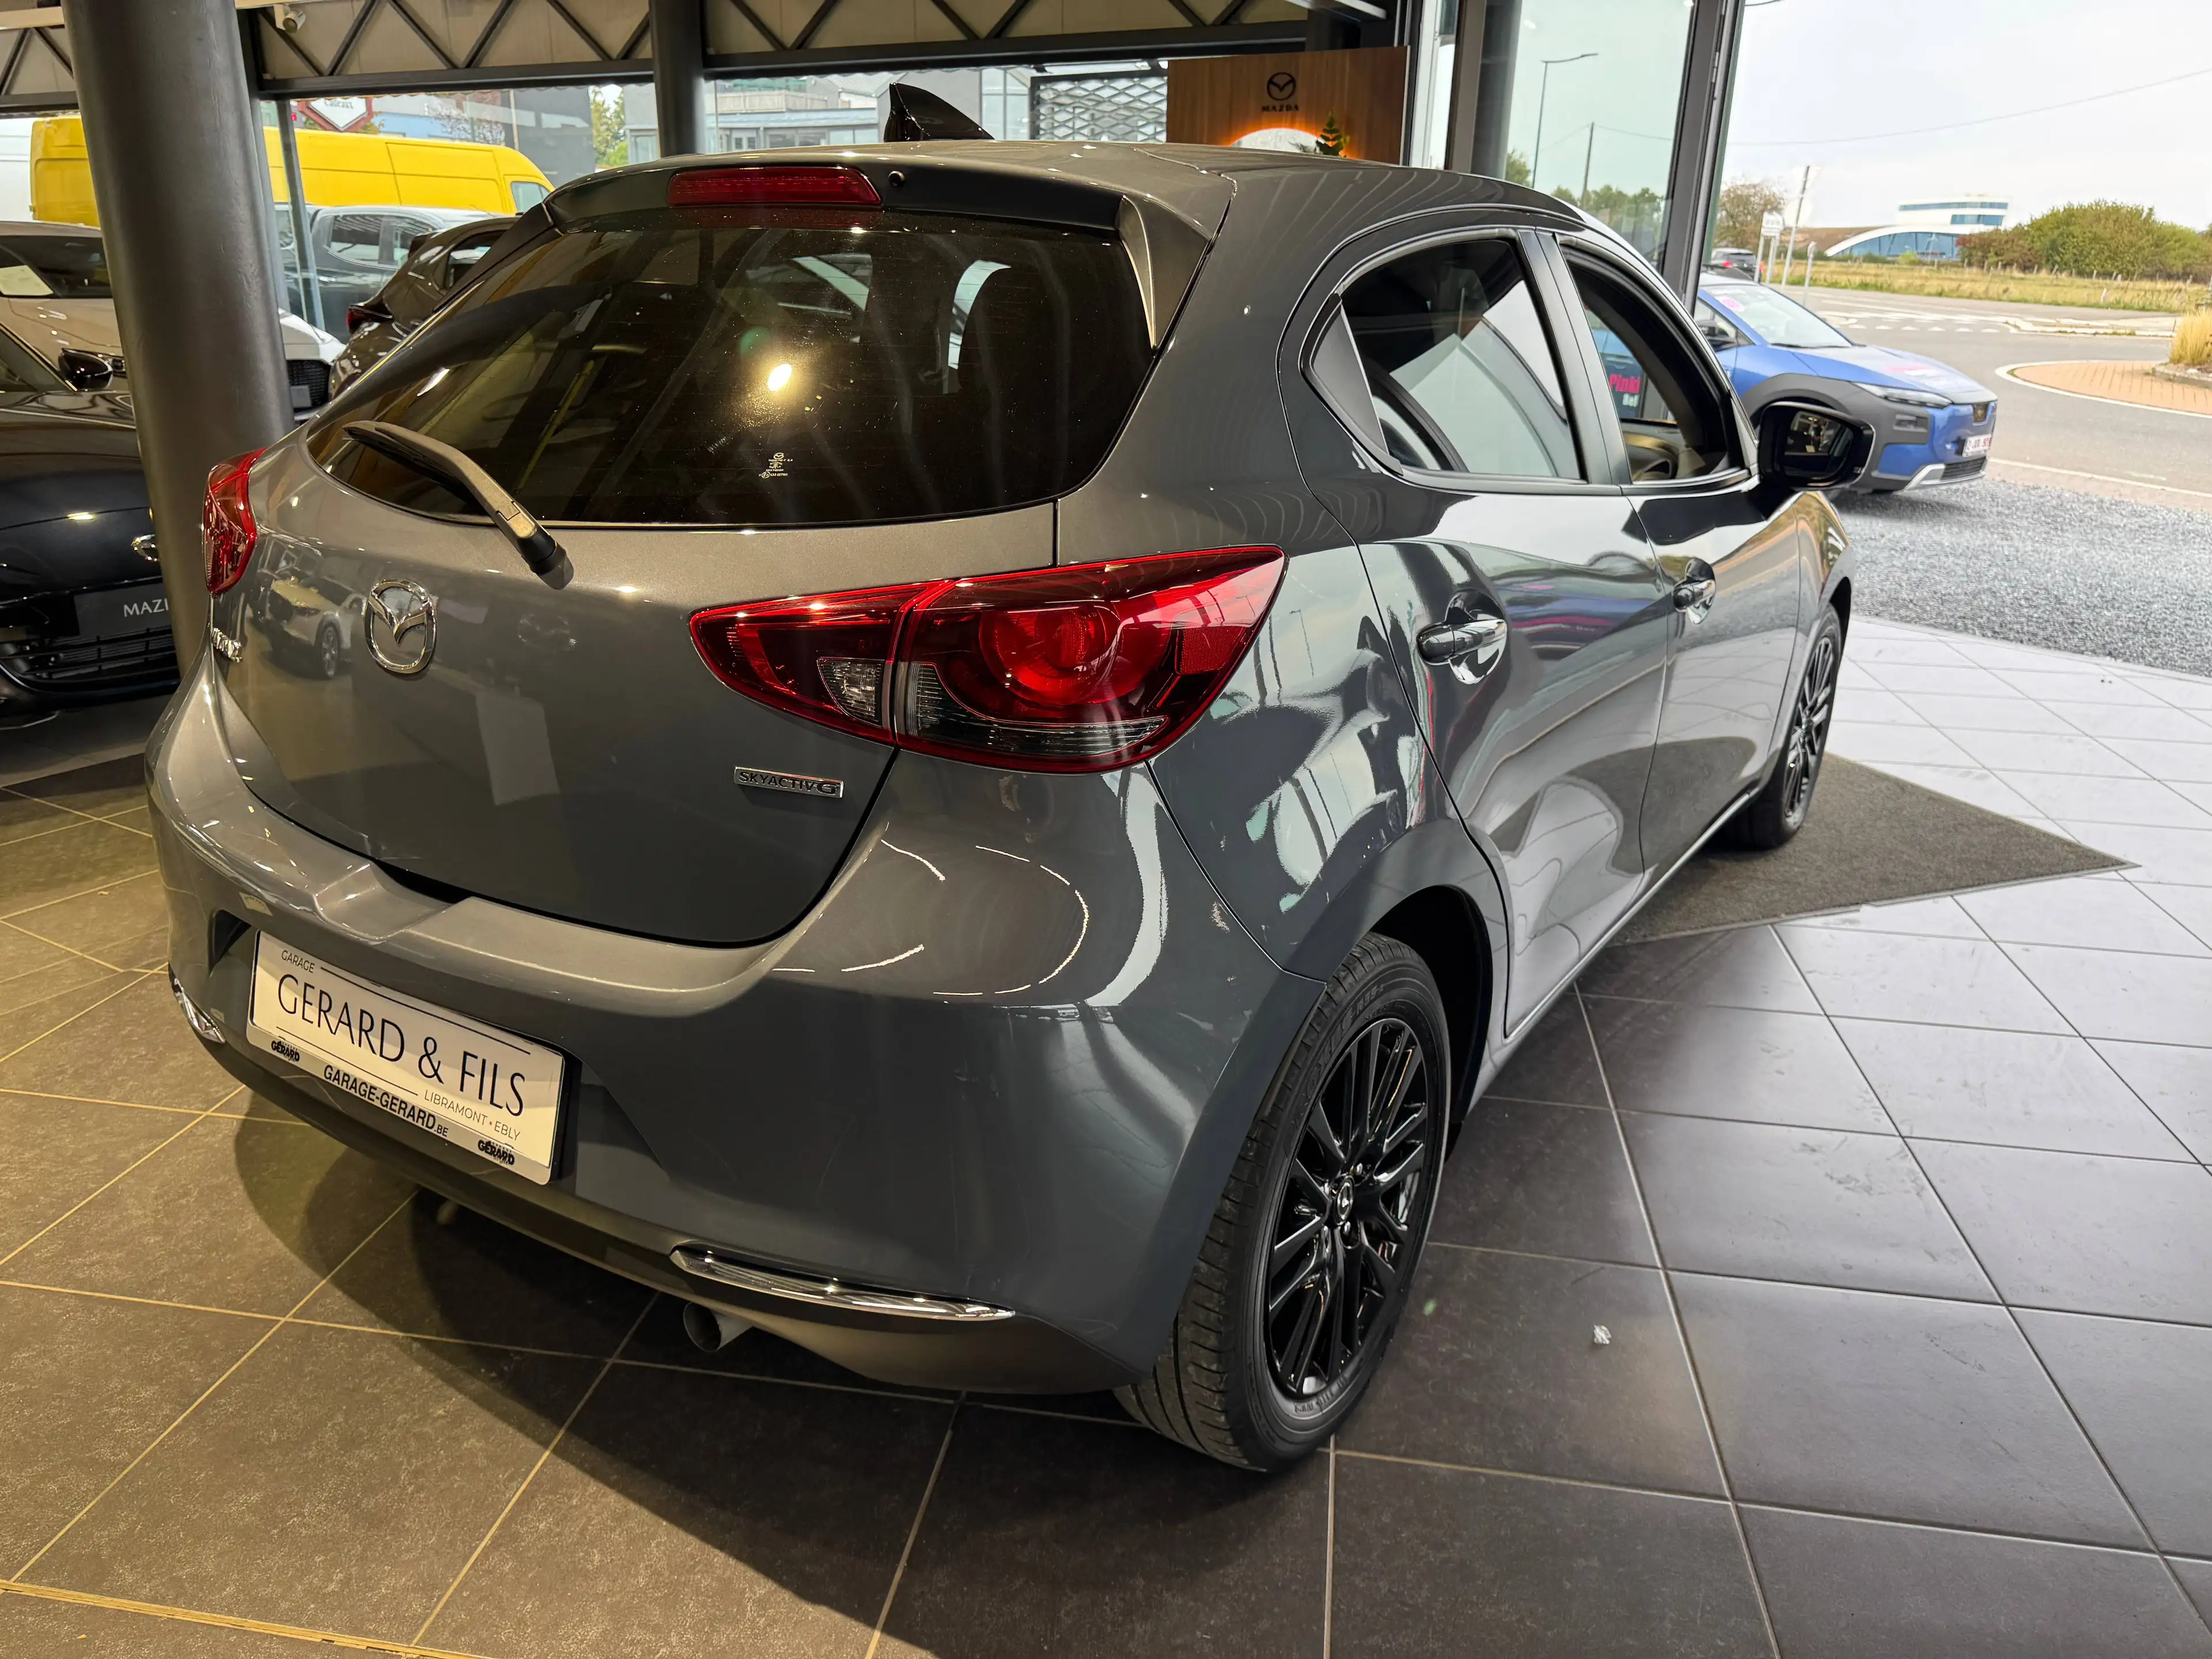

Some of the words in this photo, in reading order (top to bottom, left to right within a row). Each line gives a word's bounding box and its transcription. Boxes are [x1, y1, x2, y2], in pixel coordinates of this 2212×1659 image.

[1262, 104, 1299, 113] MAZDA
[281, 949, 316, 974] GARAGE
[278, 974, 404, 1062] GERARD
[418, 1036, 444, 1084] &
[460, 1051, 525, 1117] FILS
[425, 1089, 488, 1126] LIBRAMONT
[494, 1121, 521, 1141] EBLY
